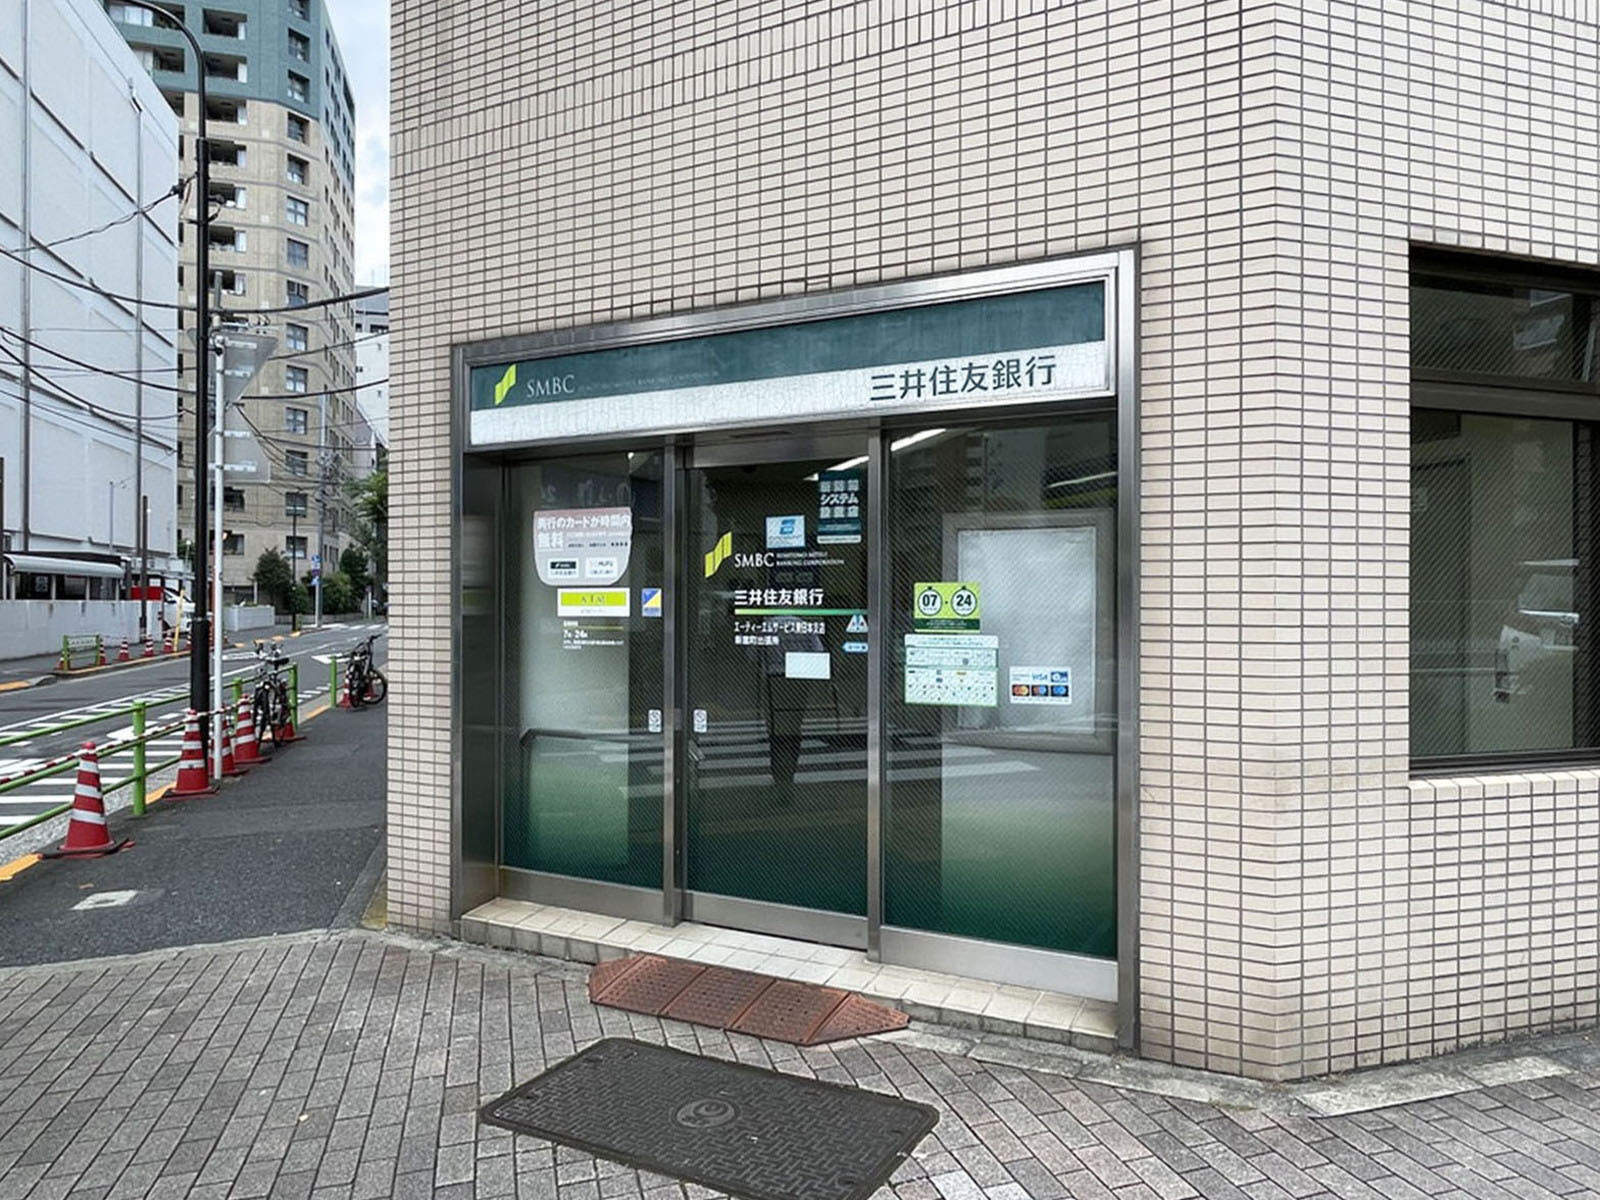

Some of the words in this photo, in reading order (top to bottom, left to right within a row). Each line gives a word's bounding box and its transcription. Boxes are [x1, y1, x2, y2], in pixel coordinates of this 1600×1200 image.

[525, 374, 576, 398] SMBC
[870, 355, 1057, 403] 三井住友銀行
[820, 492, 859, 506] システム
[734, 552, 774, 568] SMBC
[734, 588, 824, 606] 三井住友銀行
[922, 593, 938, 607] 07
[956, 593, 972, 607] 24
